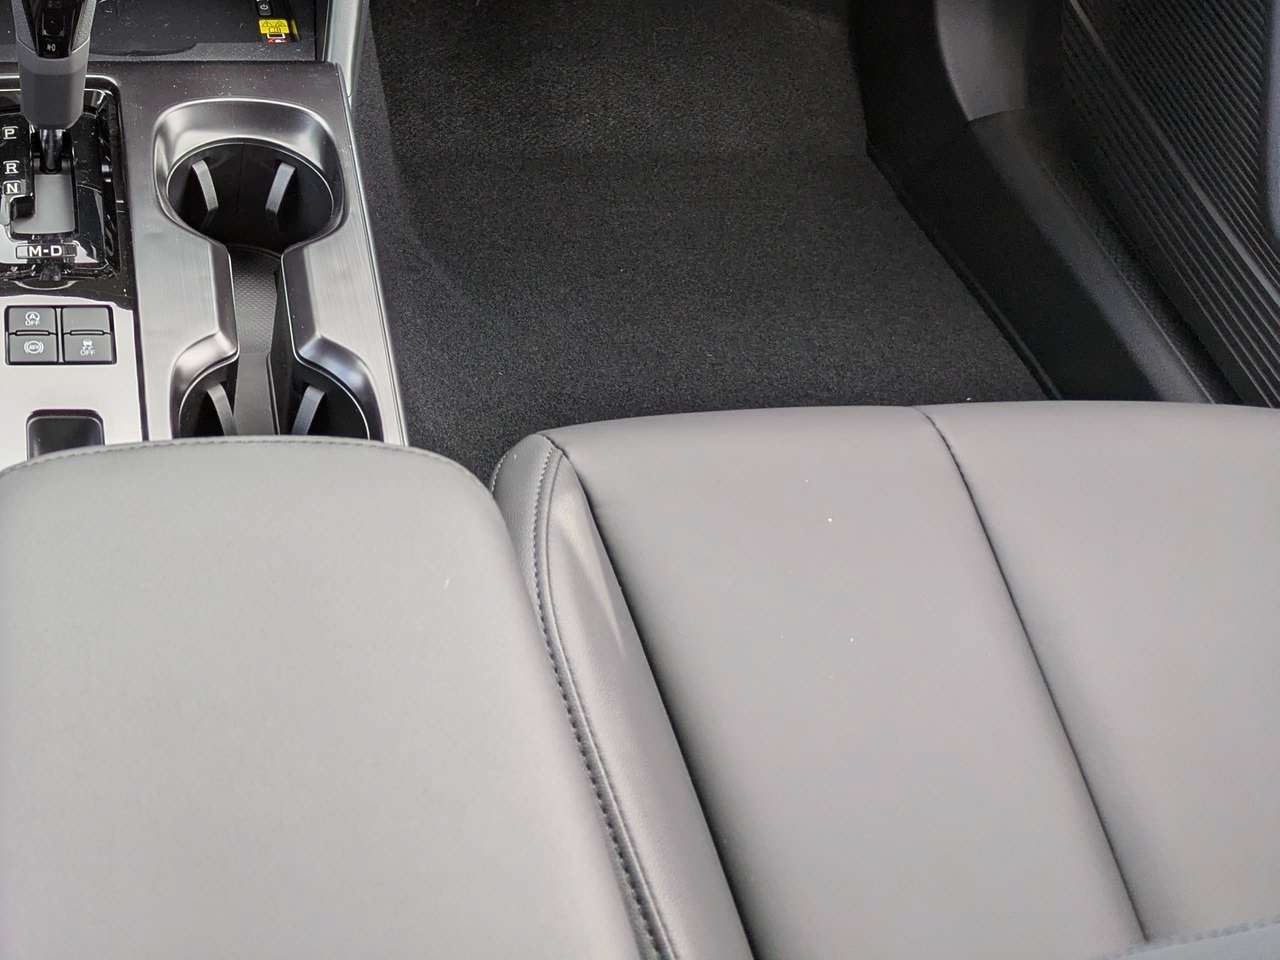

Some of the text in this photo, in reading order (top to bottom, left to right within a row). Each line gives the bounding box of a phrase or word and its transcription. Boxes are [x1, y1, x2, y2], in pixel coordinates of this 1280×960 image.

[6, 162, 18, 174] R
[6, 184, 18, 193] N
[29, 245, 62, 257] M-D
